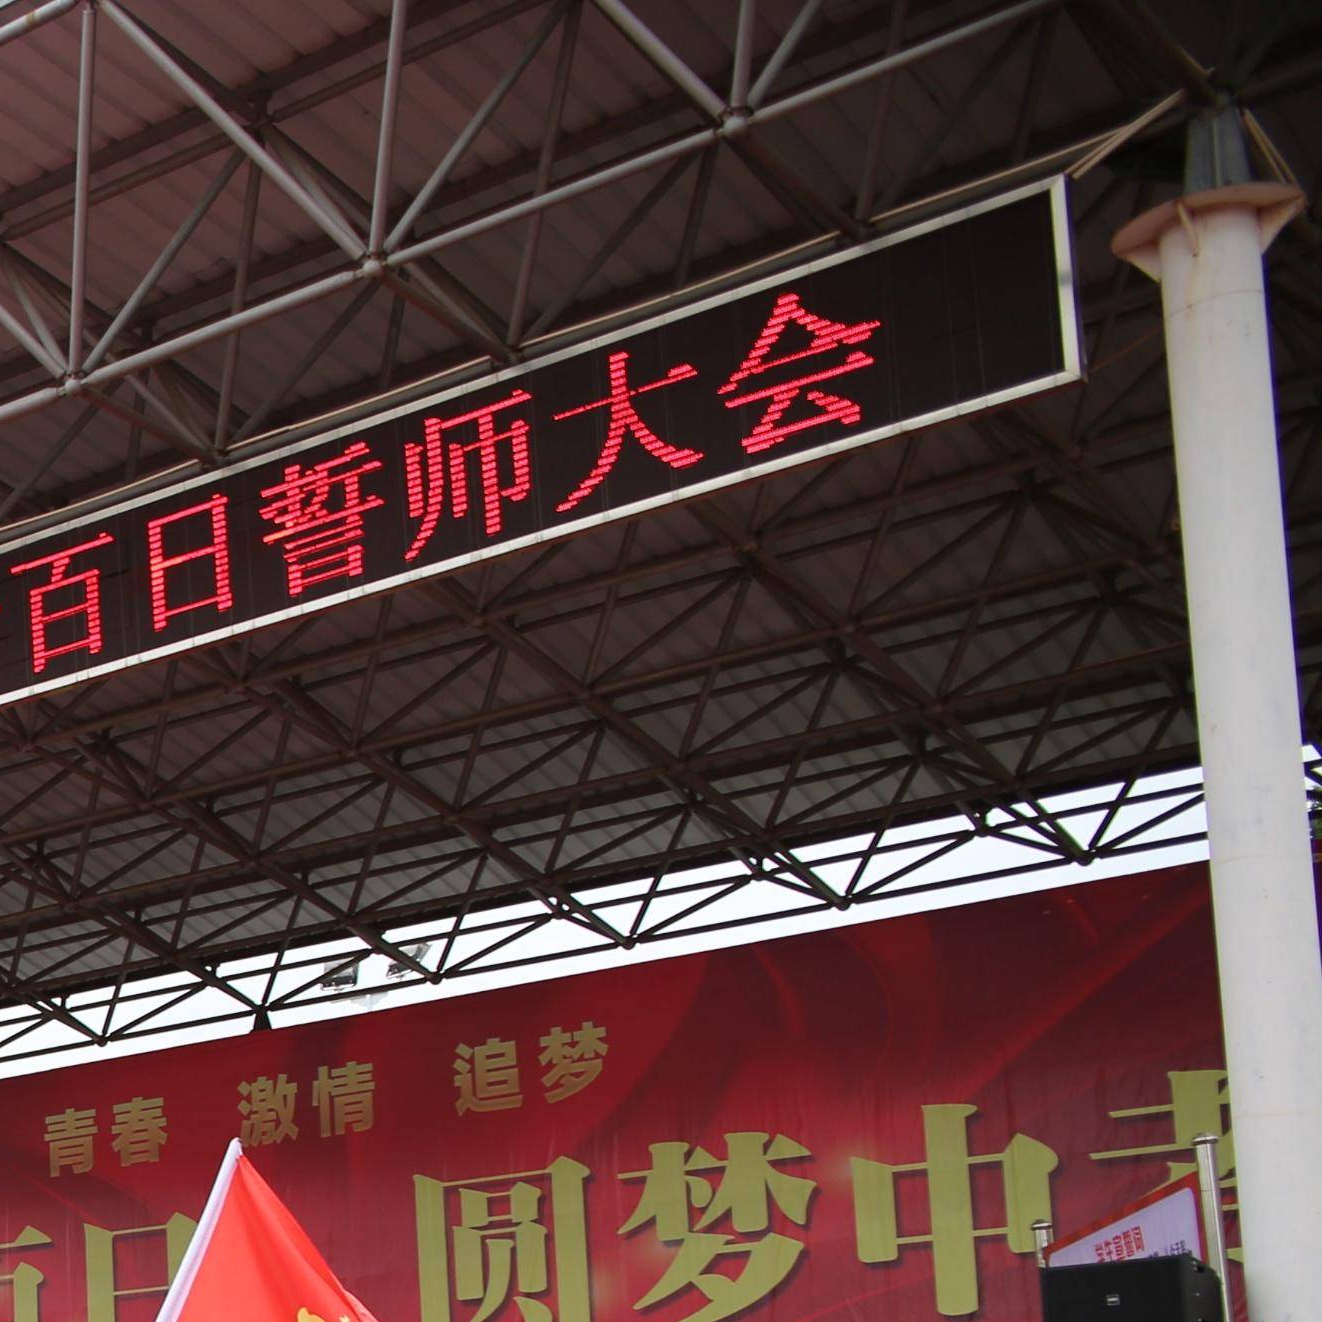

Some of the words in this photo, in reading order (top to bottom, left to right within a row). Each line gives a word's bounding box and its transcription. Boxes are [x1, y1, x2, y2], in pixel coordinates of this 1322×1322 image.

[43, 1096, 168, 1178] 青春
[236, 1061, 376, 1148] 激情
[452, 1020, 609, 1117] 追梦
